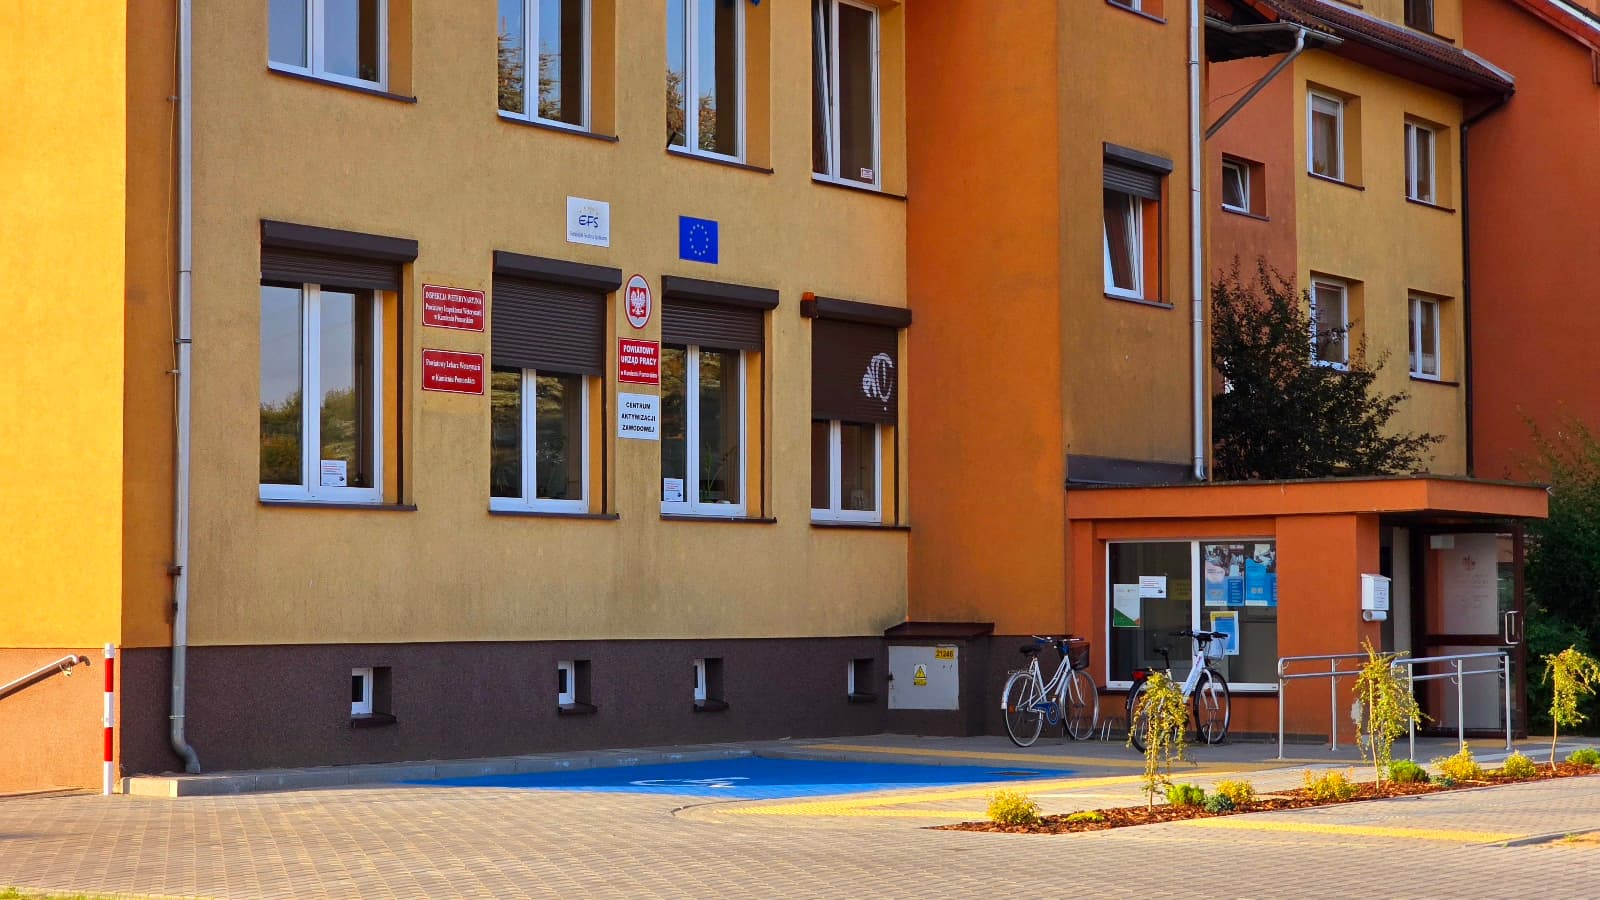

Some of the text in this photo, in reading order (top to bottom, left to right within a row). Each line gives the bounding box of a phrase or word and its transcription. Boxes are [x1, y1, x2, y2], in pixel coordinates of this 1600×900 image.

[579, 215, 598, 228] EFS
[623, 345, 654, 354] POWIATOWY
[621, 355, 656, 366] URZĄD PRACY
[622, 413, 655, 422] AKTYWIZACJI
